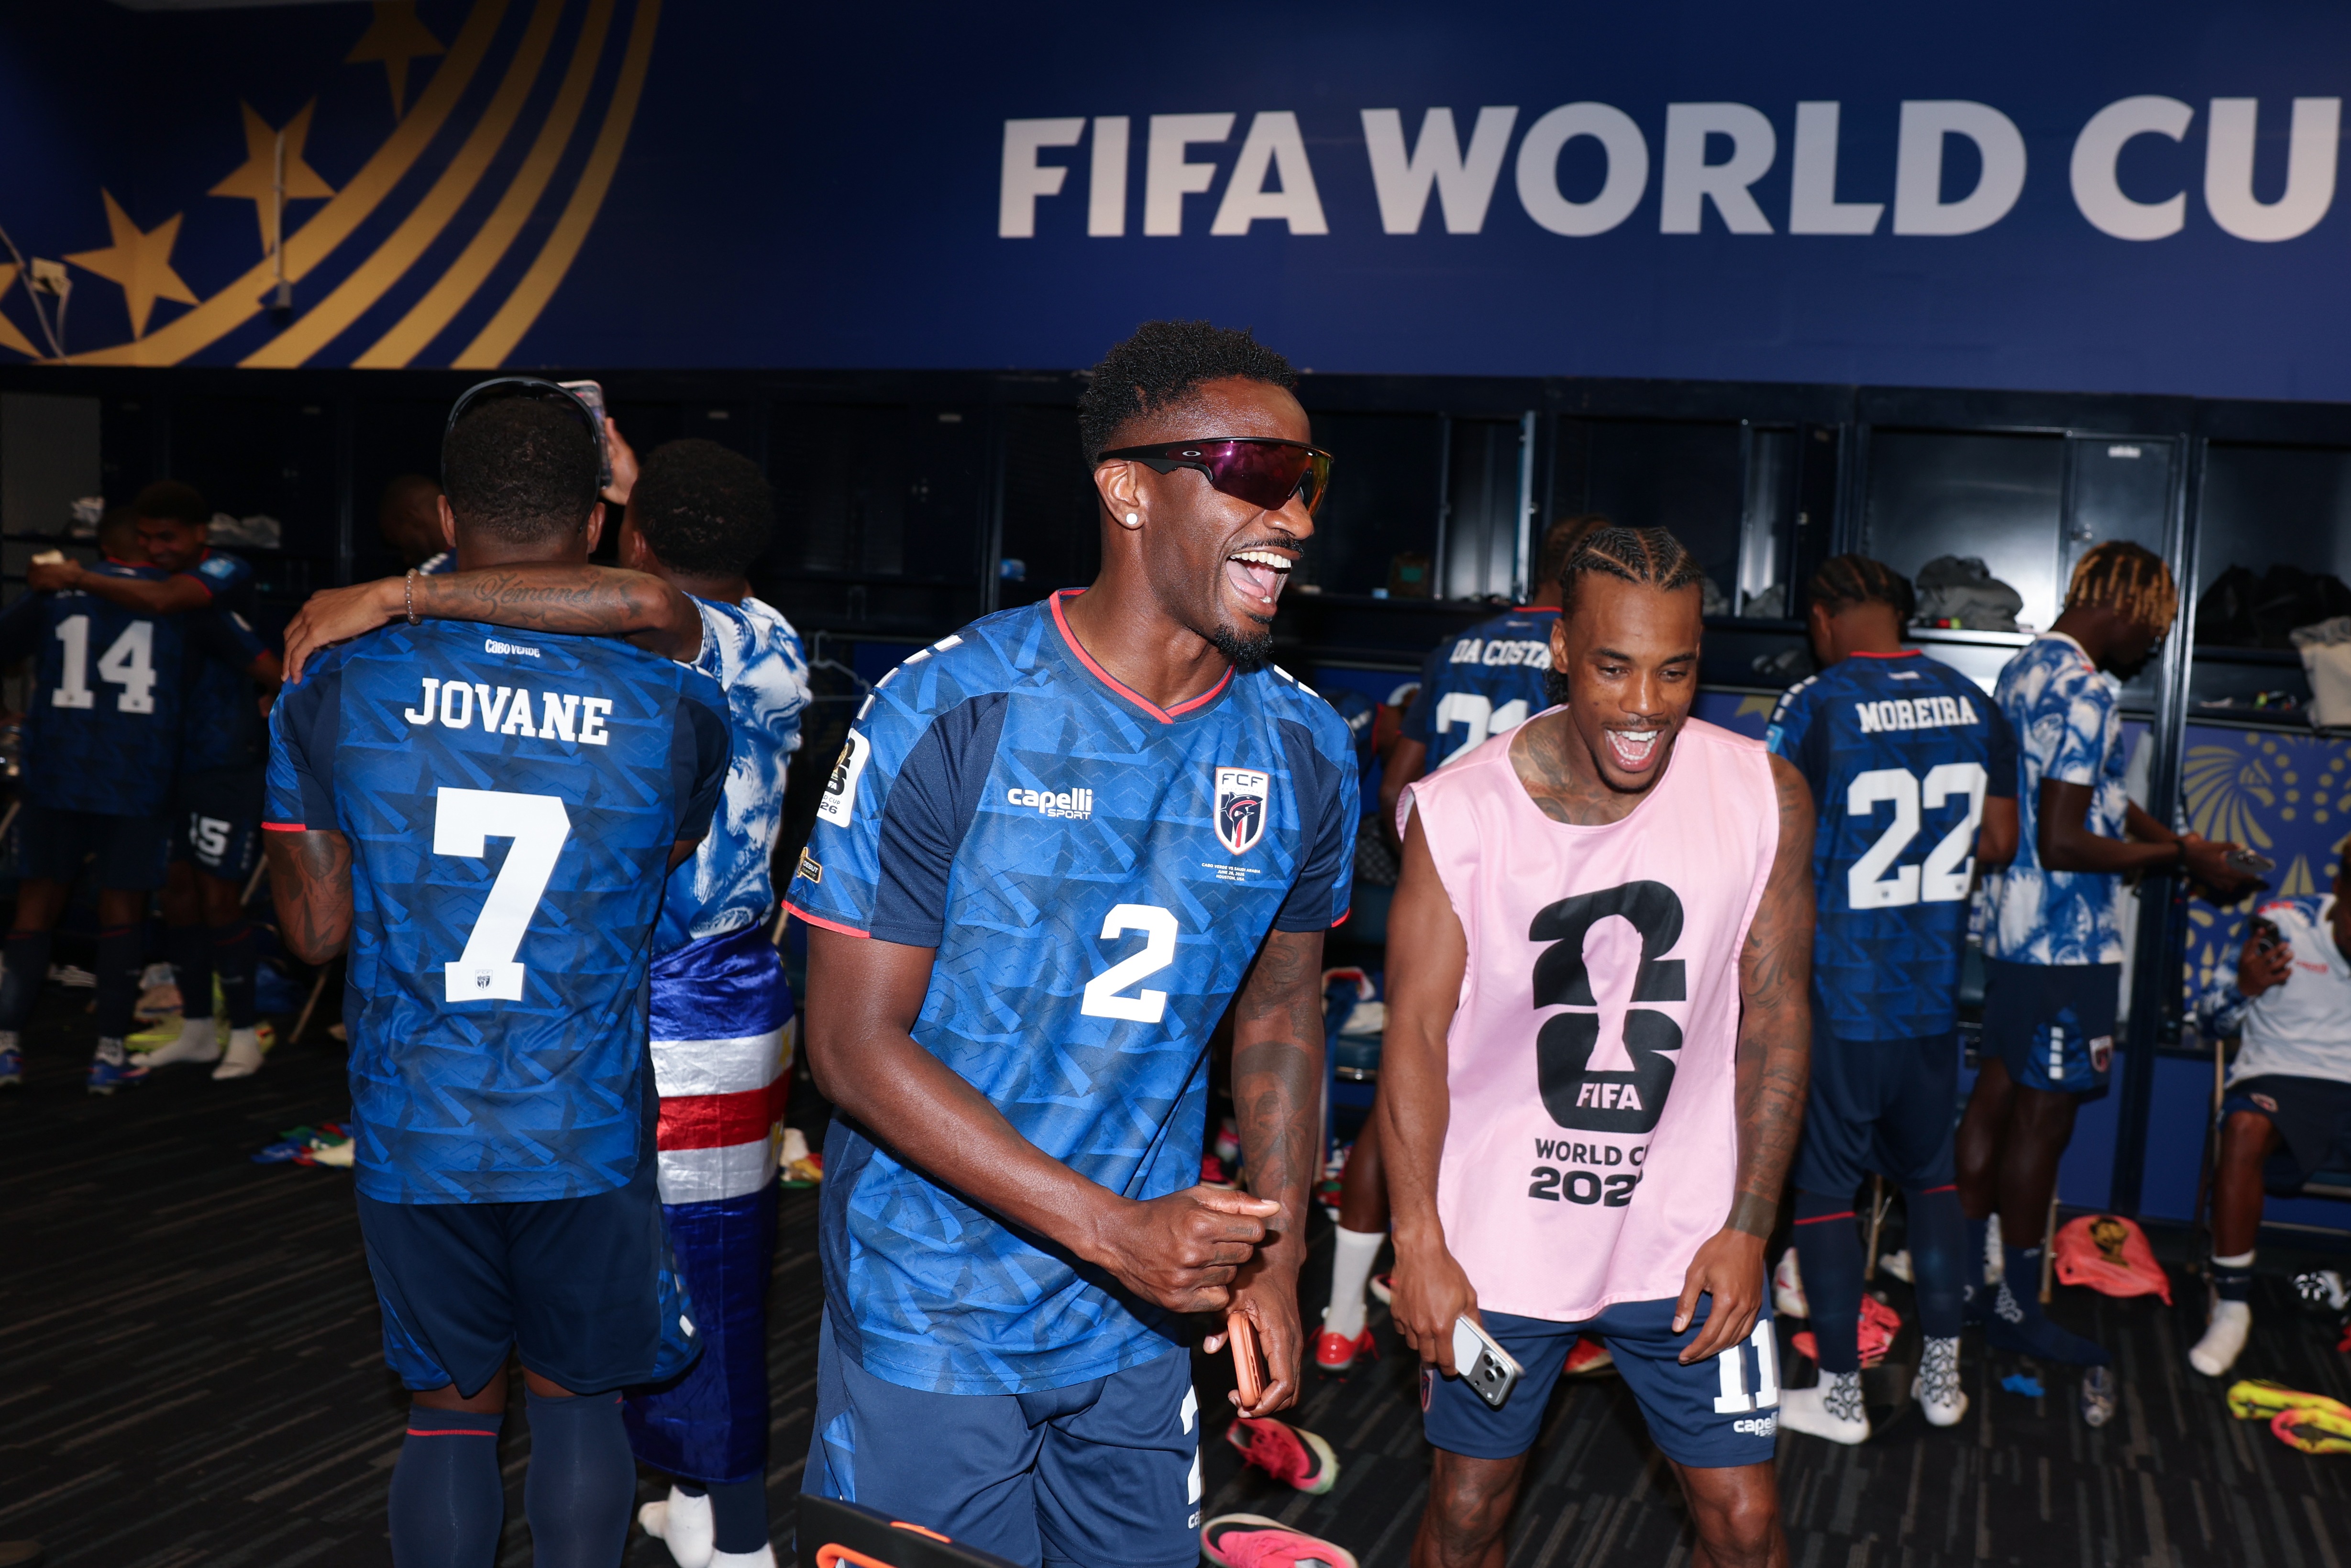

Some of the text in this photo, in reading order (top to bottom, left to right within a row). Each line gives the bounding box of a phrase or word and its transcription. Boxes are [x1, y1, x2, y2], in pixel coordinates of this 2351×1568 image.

[999, 95, 2341, 243] FIFA WORLD CU
[51, 614, 157, 714] 14
[1449, 638, 1552, 670] DA COSTA
[404, 677, 613, 746] JOVANE
[1855, 695, 1979, 733] MOREIRA
[1222, 773, 1263, 787] FCF
[1008, 788, 1092, 814] capelli
[1047, 809, 1091, 820] SPORT
[1847, 762, 1988, 910] 22
[803, 860, 818, 873] DEBUT
[433, 787, 571, 1002] 7
[1080, 904, 1179, 1023] 2
[1576, 1082, 1643, 1111] FIFA
[1534, 1138, 1649, 1166] WORLD C
[1528, 1166, 1643, 1207] 202
[1713, 1318, 1778, 1414] 11
